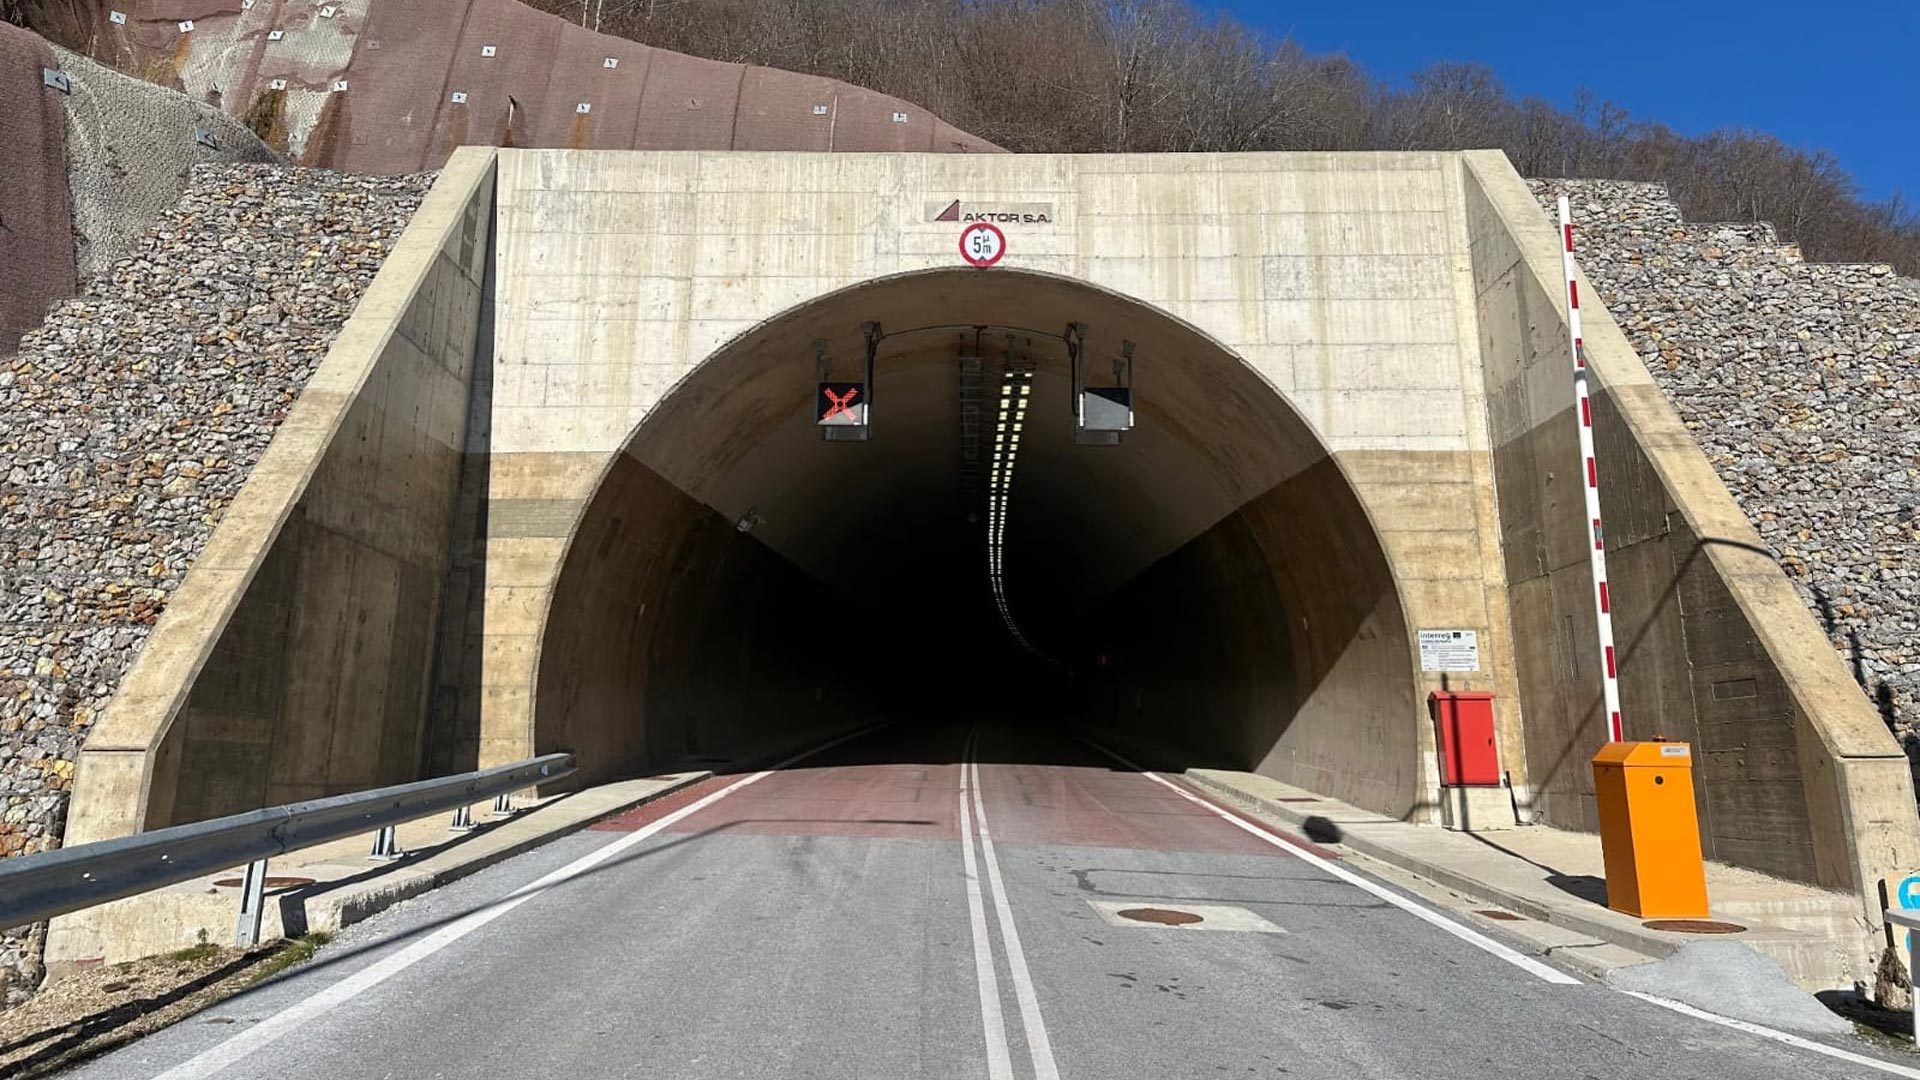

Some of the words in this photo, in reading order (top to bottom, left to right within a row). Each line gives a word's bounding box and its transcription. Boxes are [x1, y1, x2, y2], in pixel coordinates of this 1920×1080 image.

[963, 213, 1020, 222] AKTOR
[1023, 214, 1052, 223] S.A.
[973, 236, 981, 254] 5
